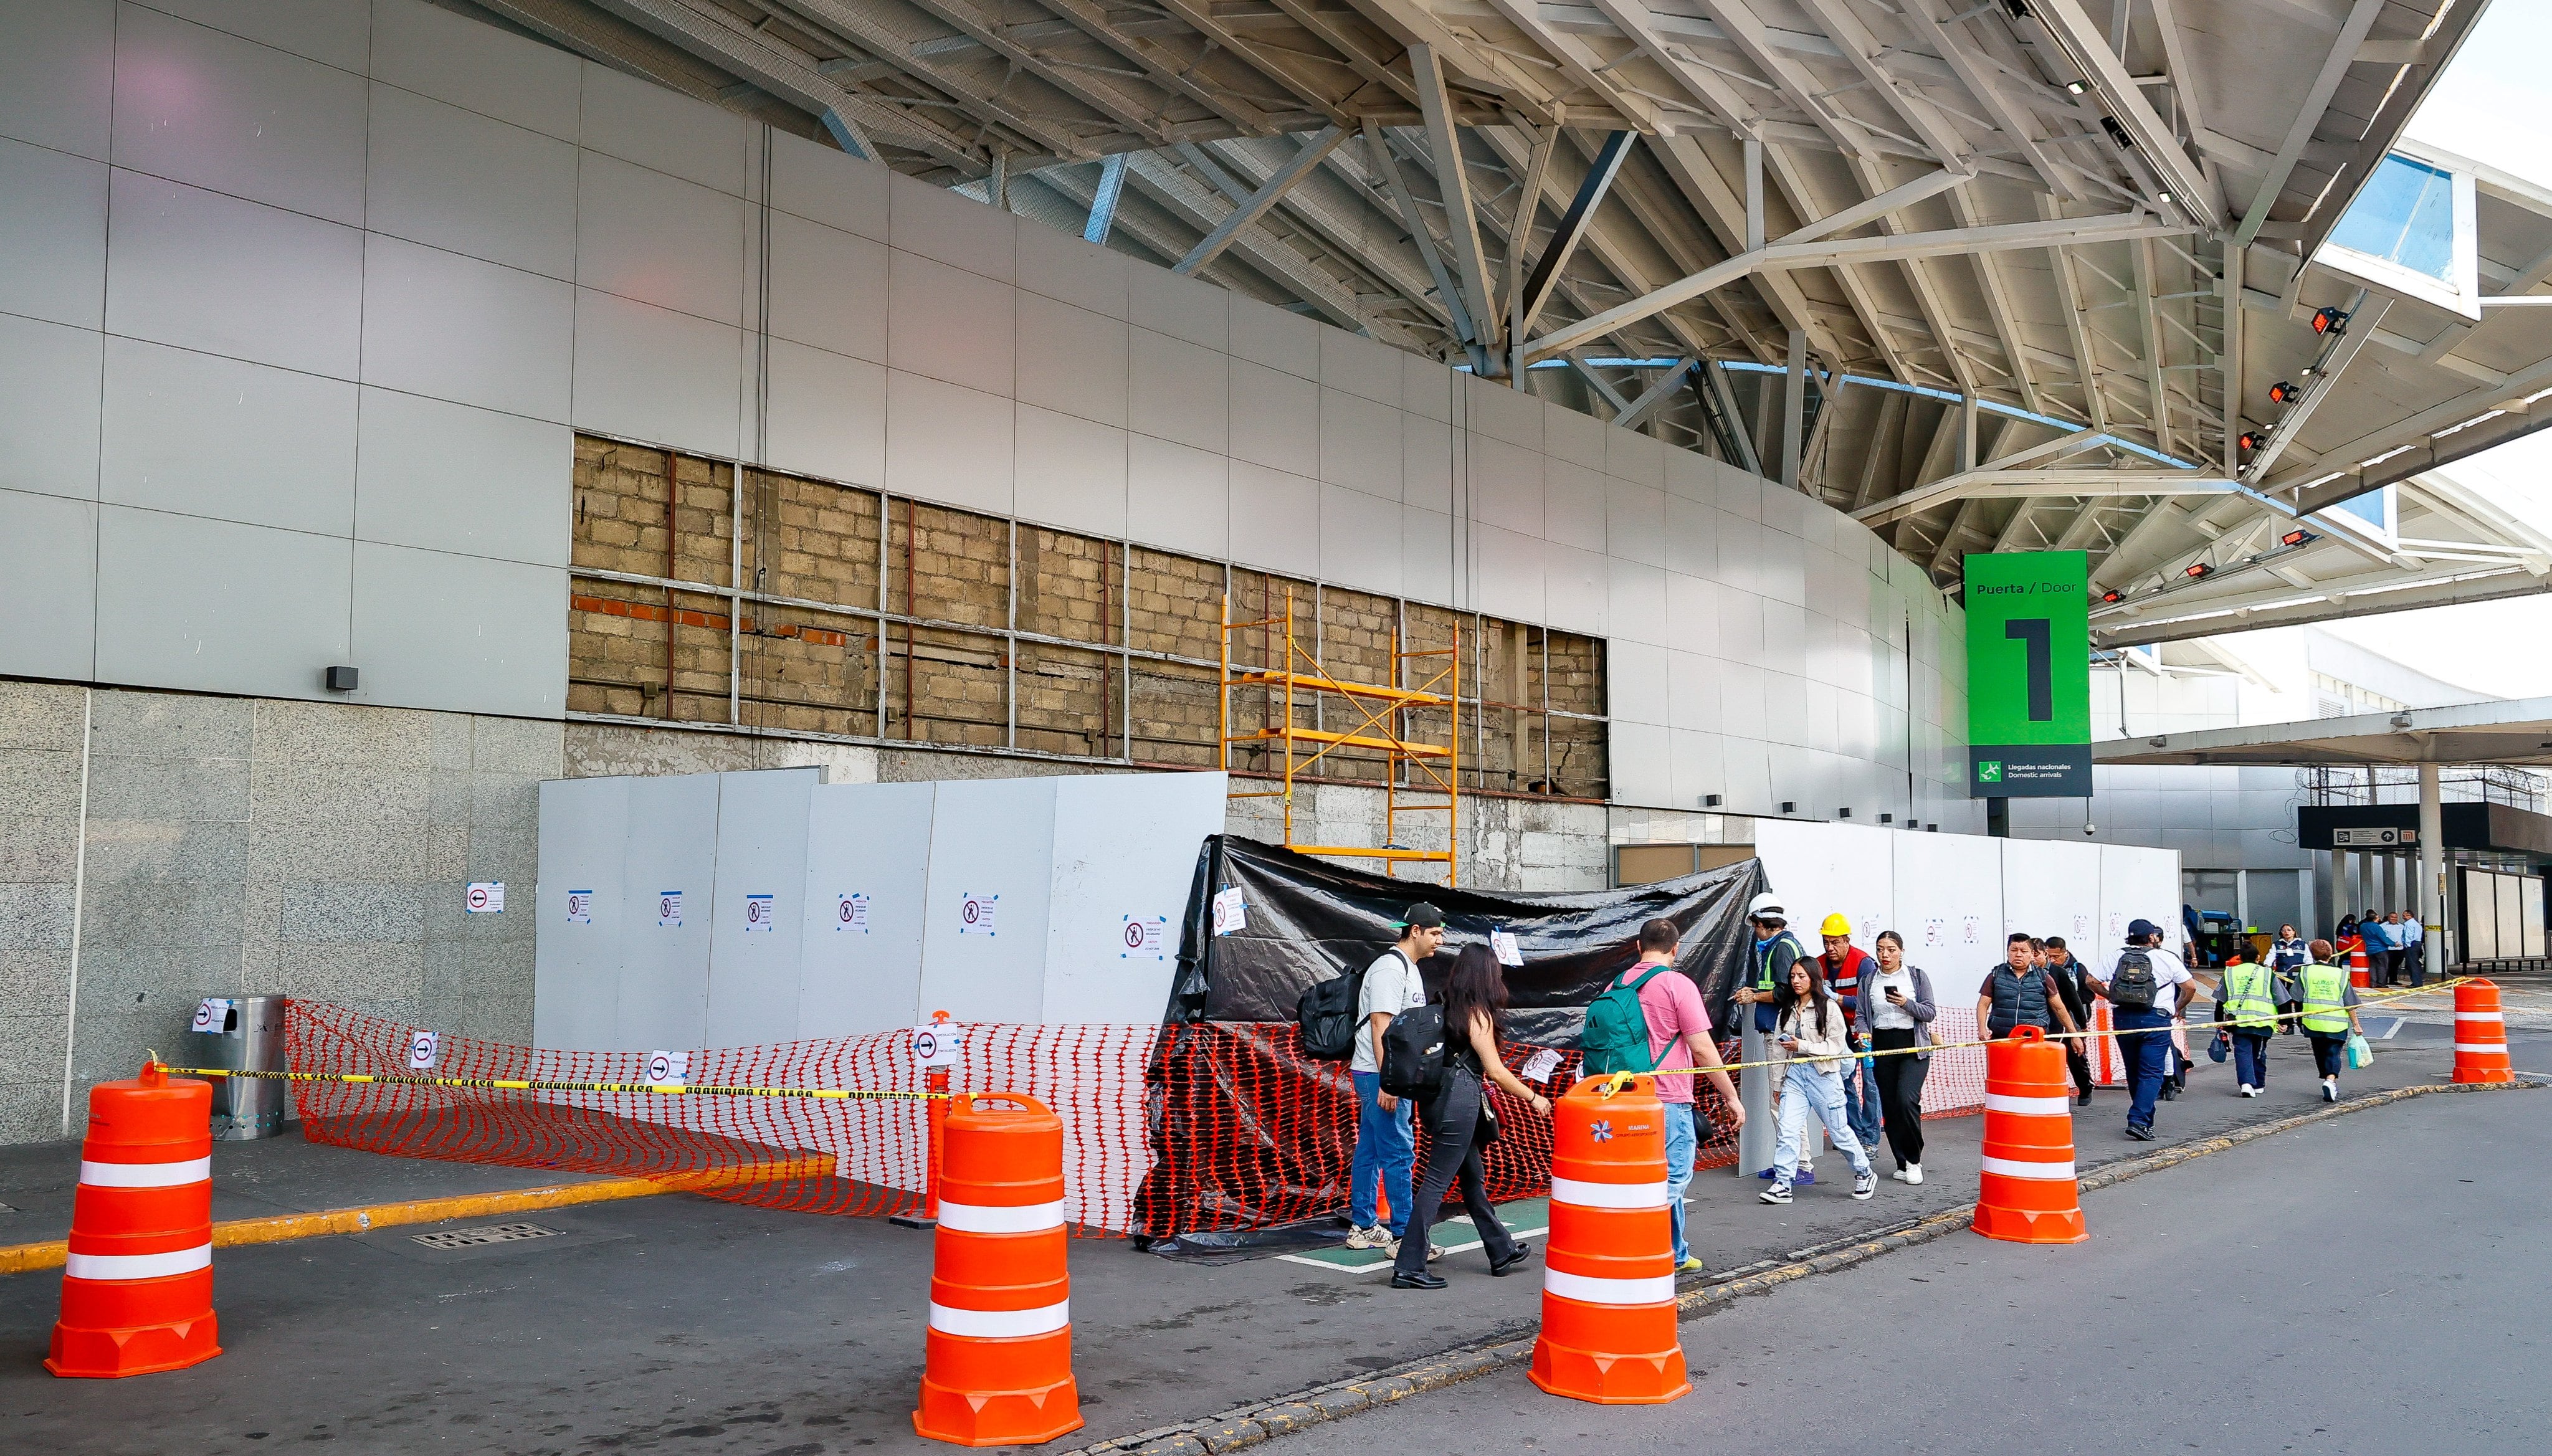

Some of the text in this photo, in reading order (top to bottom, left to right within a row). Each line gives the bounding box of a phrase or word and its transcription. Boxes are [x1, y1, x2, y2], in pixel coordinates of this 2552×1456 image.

[1977, 581, 2077, 595] Puerta / Door
[2005, 618, 2052, 721] 1
